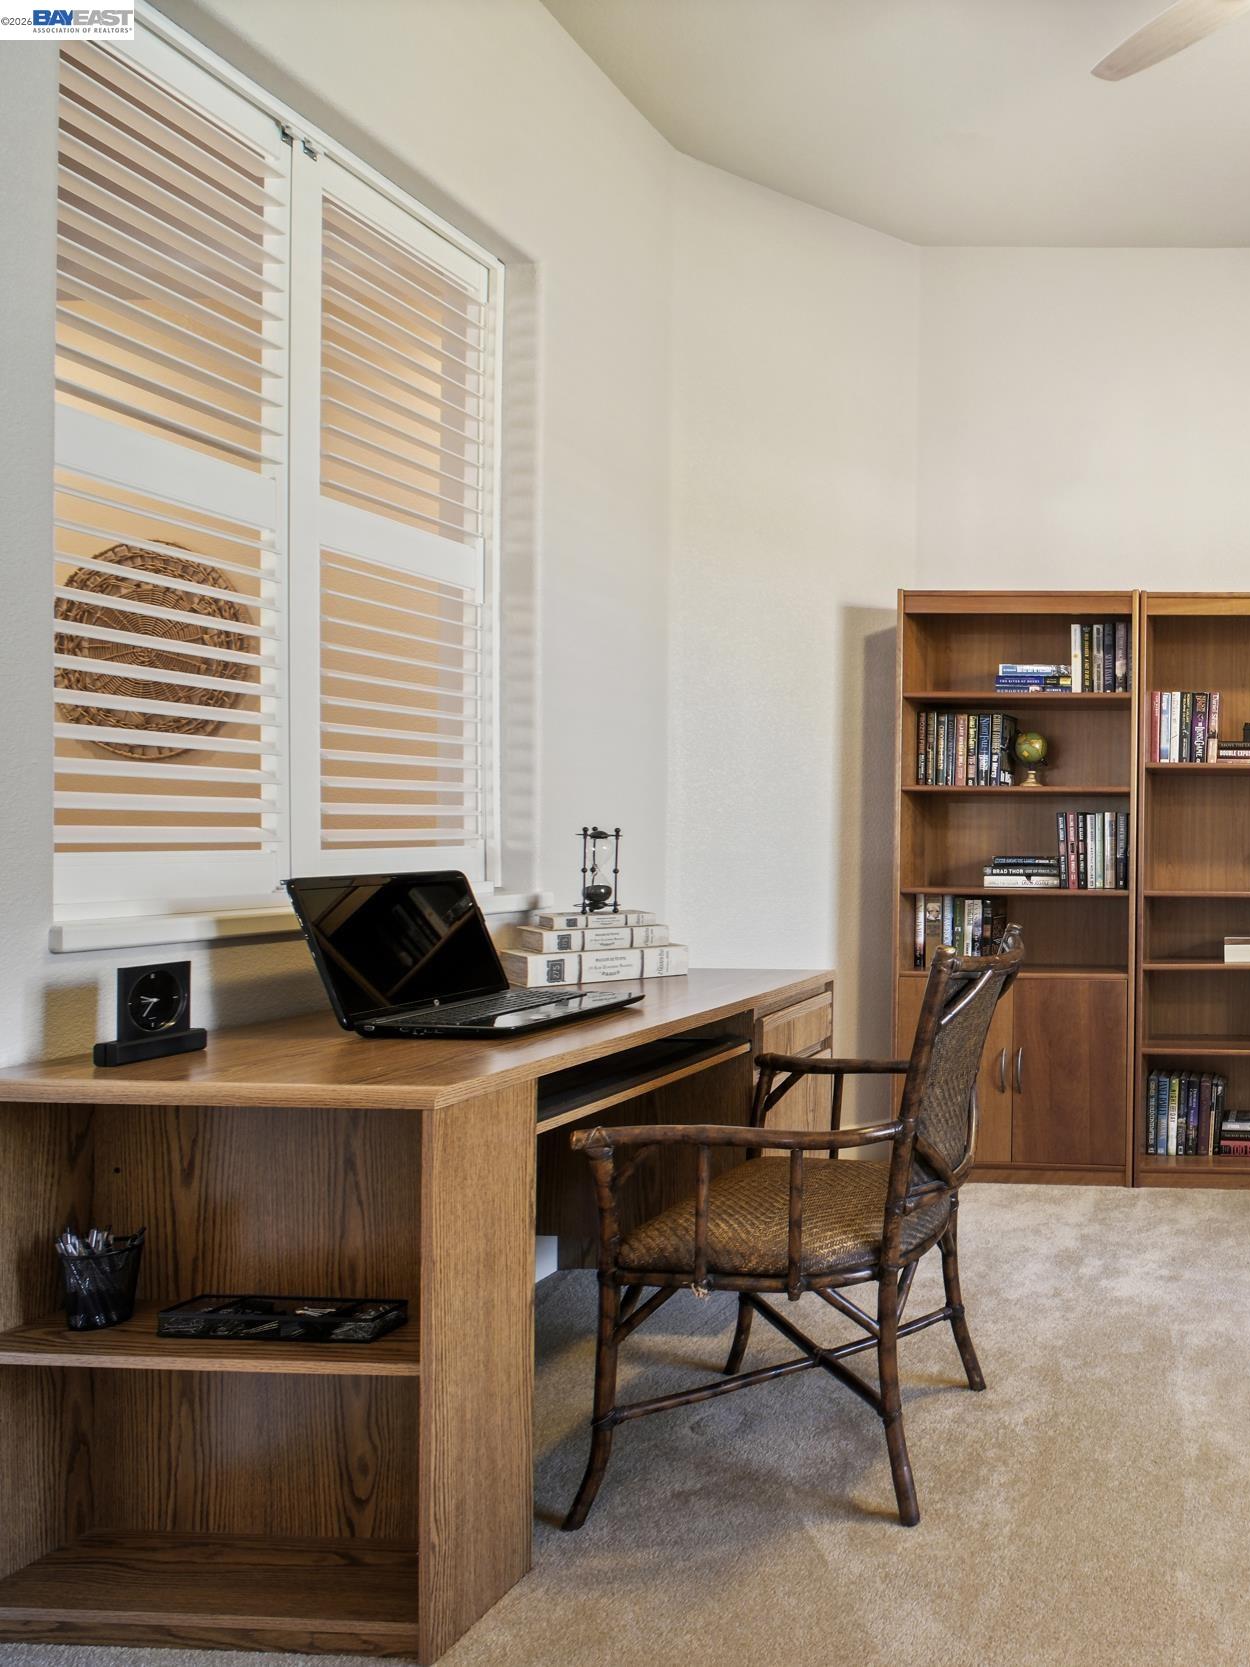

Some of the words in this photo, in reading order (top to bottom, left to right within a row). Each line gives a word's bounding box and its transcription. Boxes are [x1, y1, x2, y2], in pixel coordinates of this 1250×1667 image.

[992, 714, 1002, 731] COLIN
[992, 732, 1002, 753] FORBES
[1232, 1144, 1247, 1156] TOO
